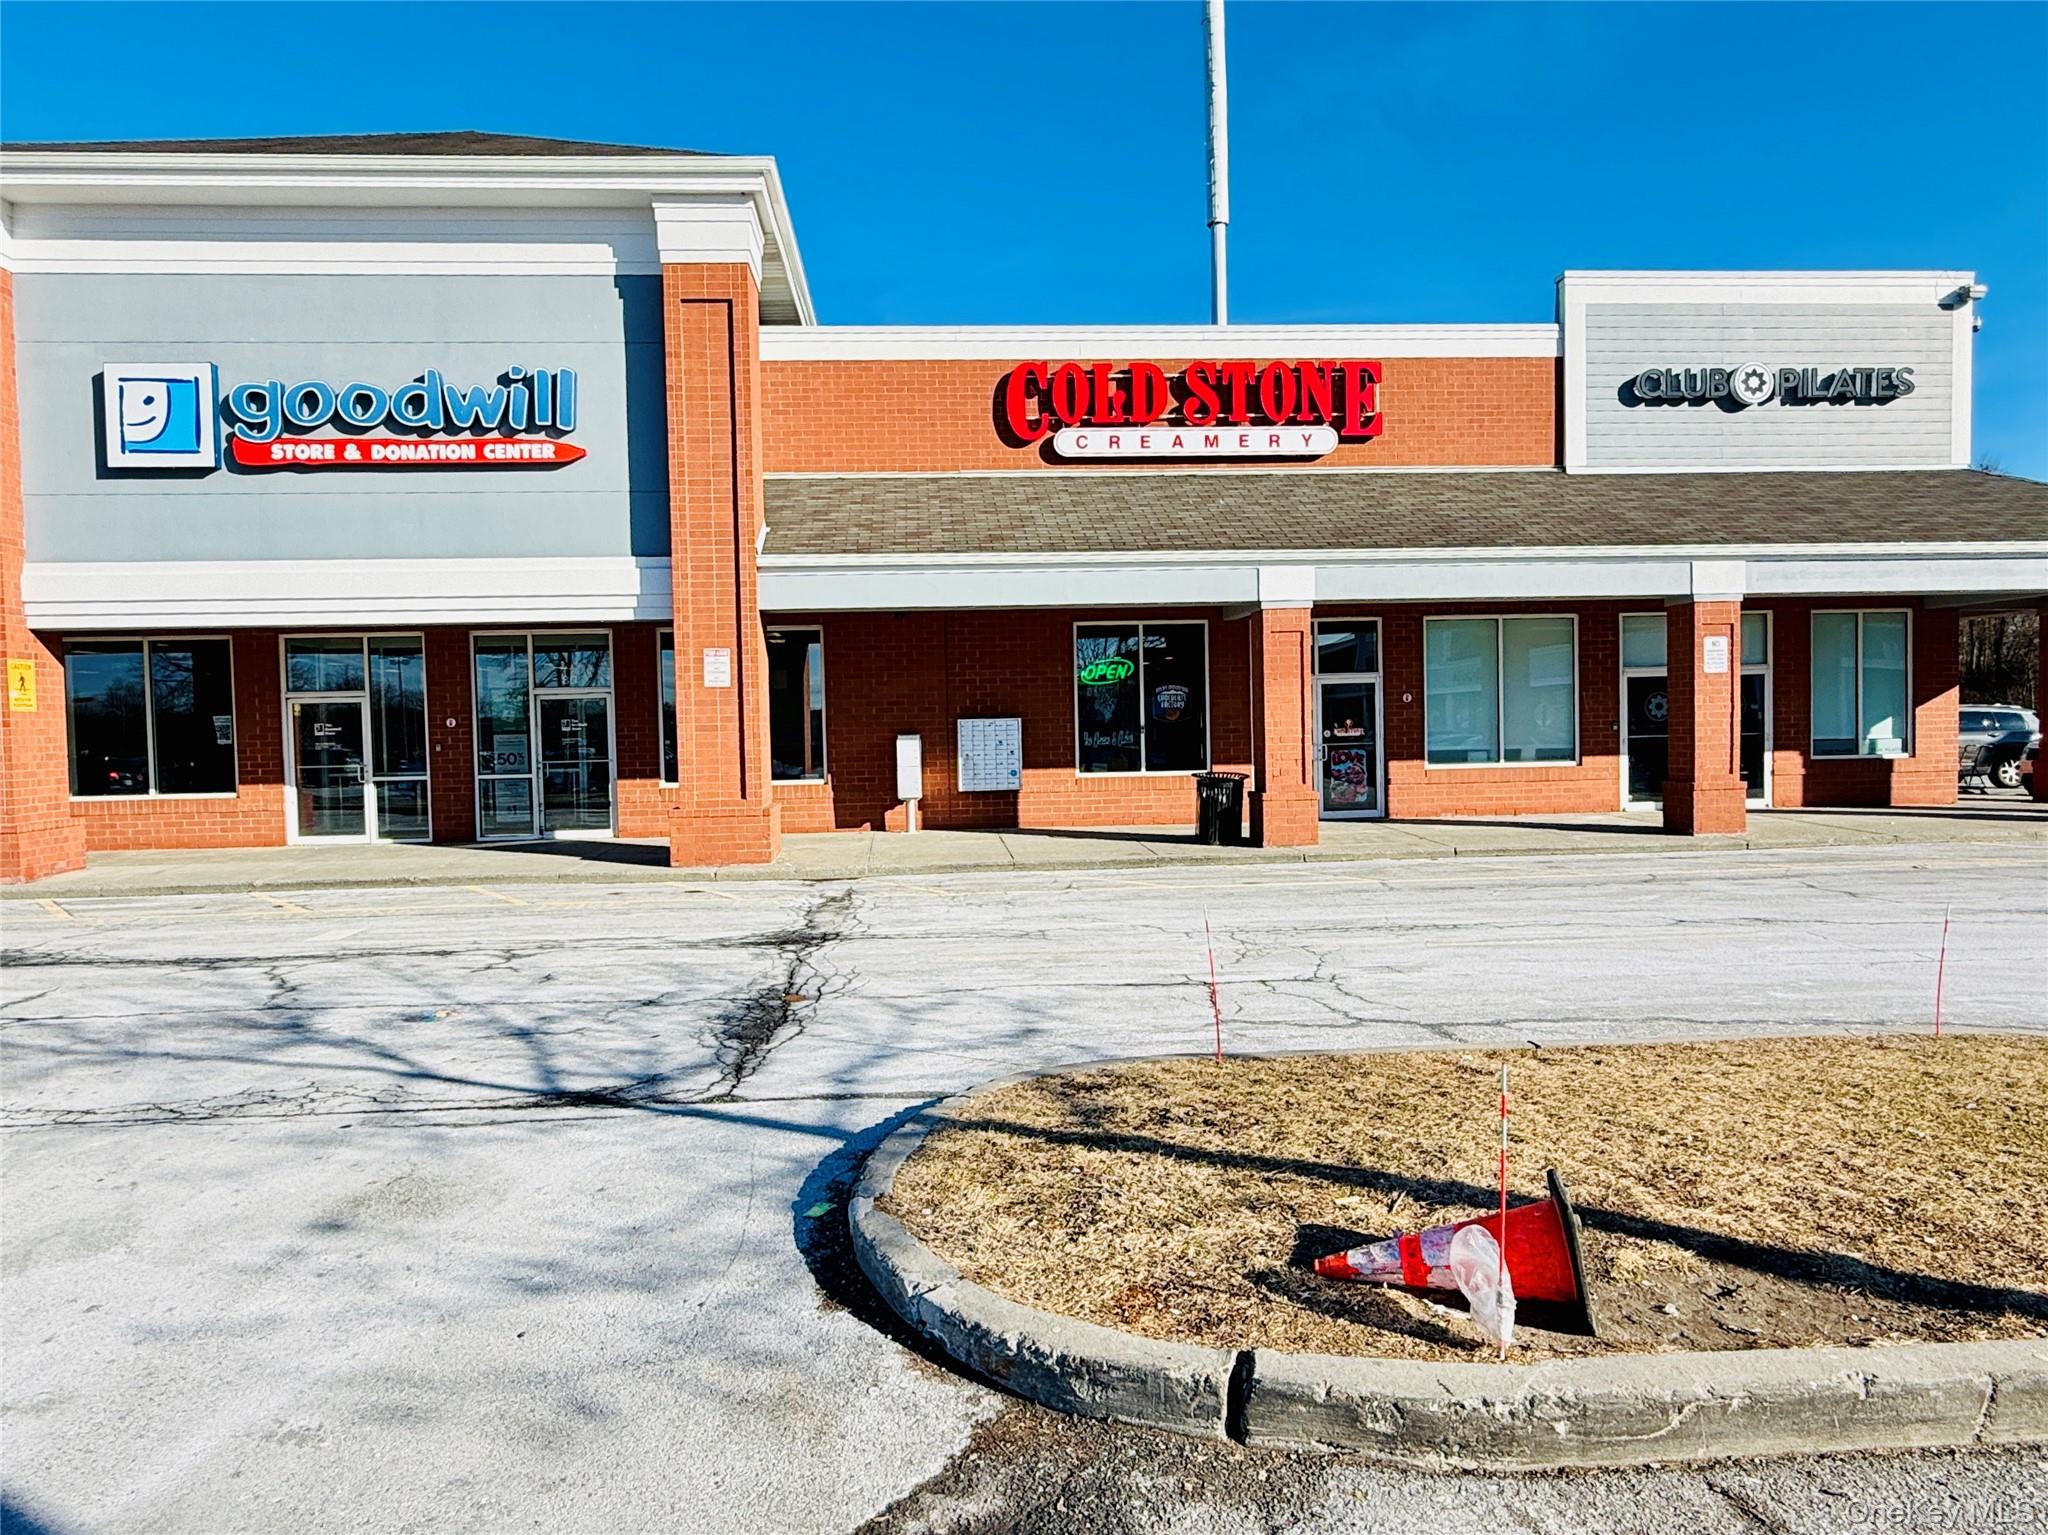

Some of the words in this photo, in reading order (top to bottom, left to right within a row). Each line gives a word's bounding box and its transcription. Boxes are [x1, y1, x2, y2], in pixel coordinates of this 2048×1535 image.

[1636, 368, 1731, 398] CLUB
[1775, 367, 1915, 397] PILATES
[229, 364, 576, 443] goodwill
[1006, 361, 1168, 441] COLD
[1184, 361, 1382, 436] STONE
[271, 444, 335, 460] STORE
[344, 444, 362, 460] &
[371, 444, 476, 460] DONATION
[483, 443, 556, 460] CENTER
[1076, 434, 1313, 449] CREAMERY
[1085, 664, 1129, 680] OPEN
